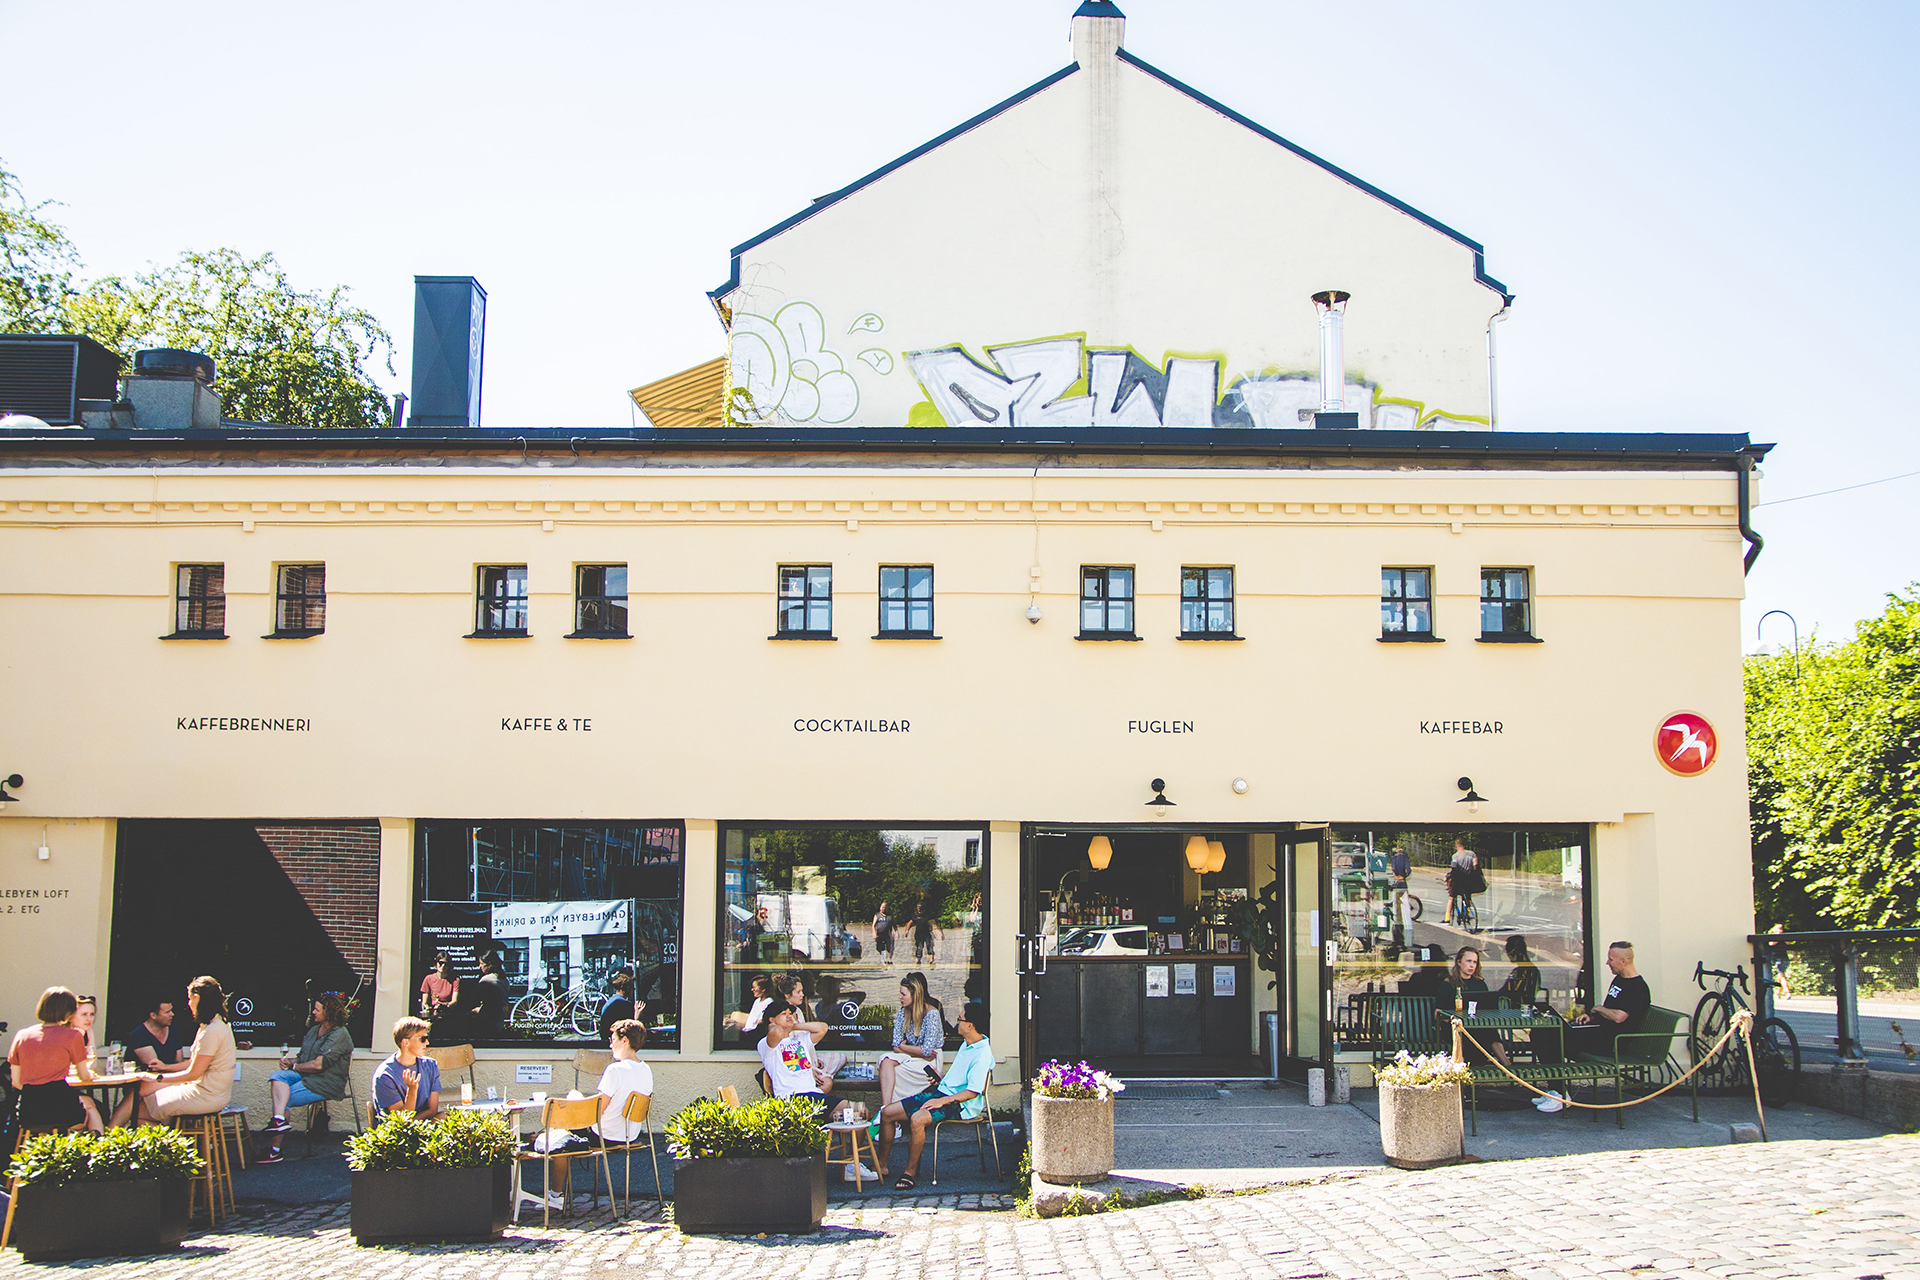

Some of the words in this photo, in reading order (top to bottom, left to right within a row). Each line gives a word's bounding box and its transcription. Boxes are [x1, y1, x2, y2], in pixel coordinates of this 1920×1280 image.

[176, 717, 311, 732] KAFFEBRENNERI
[501, 717, 552, 732] KAFFE
[556, 717, 568, 732] &
[572, 717, 592, 732] TE
[793, 718, 911, 733] COCKTAILBAR
[1128, 720, 1194, 734] FUGLEN
[1420, 720, 1504, 734] KAFFEBAR
[44, 889, 69, 898] LOFT
[21, 905, 40, 914] ETG
